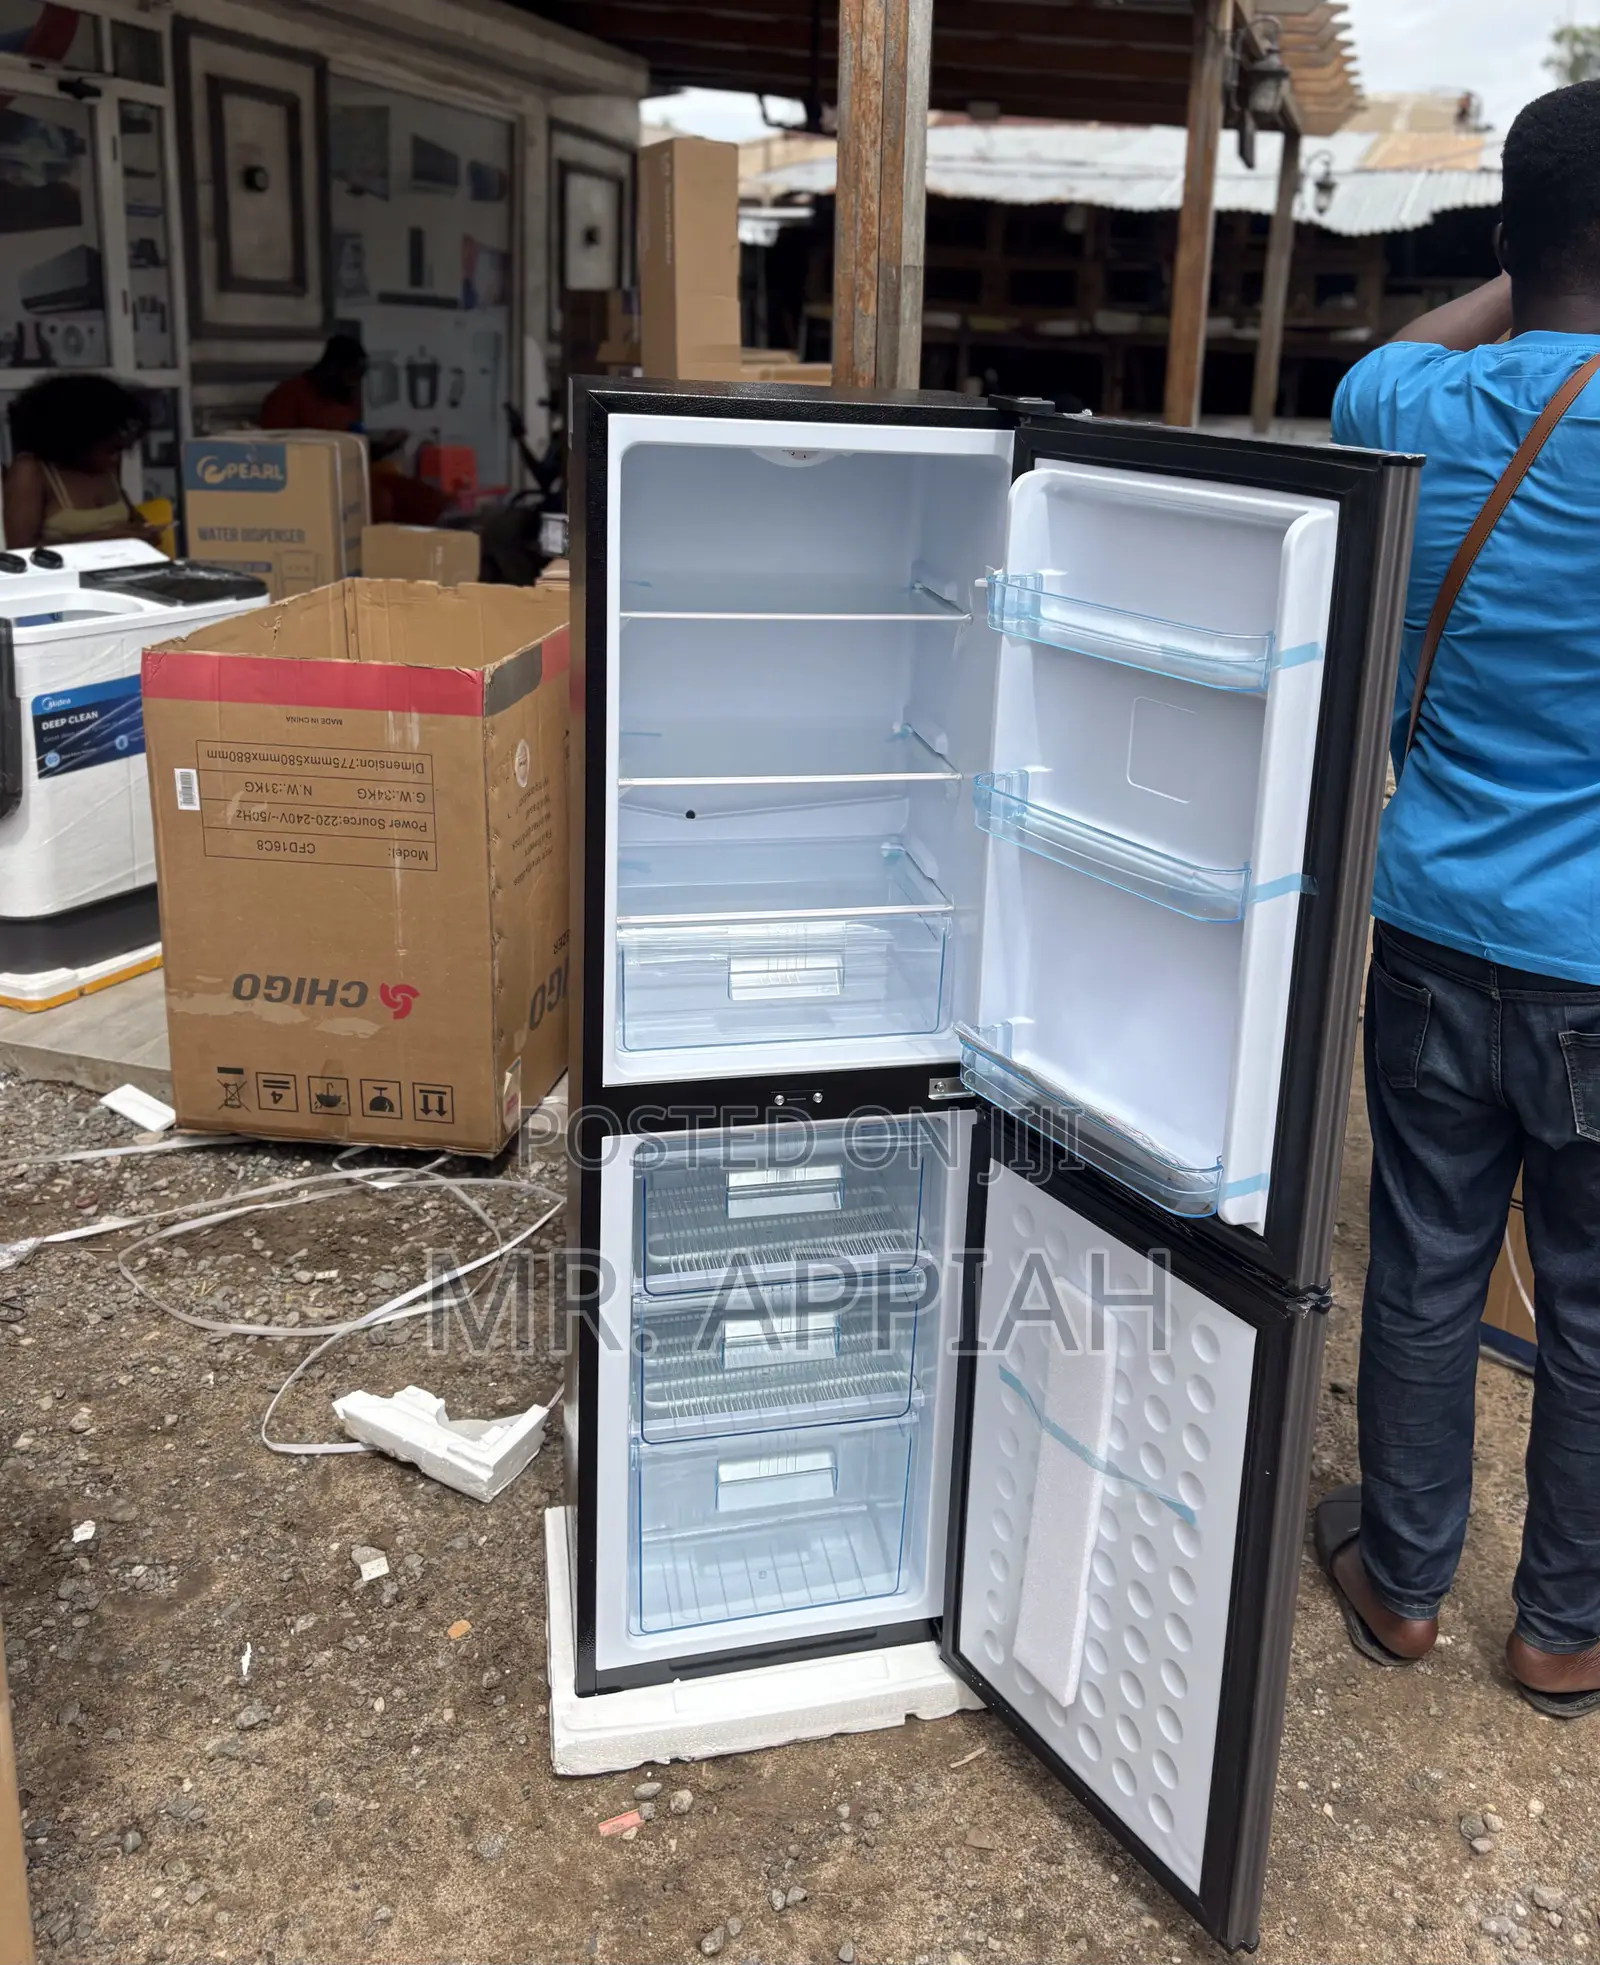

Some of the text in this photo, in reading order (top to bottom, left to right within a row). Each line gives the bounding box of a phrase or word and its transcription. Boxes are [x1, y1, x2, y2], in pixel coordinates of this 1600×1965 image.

[225, 462, 285, 481] PEARL
[197, 526, 306, 543] WATER DISPENSER
[47, 697, 72, 709] Midea
[42, 717, 67, 731] DEEP
[68, 711, 99, 725] CLEAN
[286, 715, 343, 726] MADE IN CHINA
[206, 749, 425, 774] Dimension:775mmx580mmx880mm
[388, 819, 428, 833] Power
[388, 847, 429, 861] Model:
[232, 973, 369, 1009] CHIGO
[271, 1090, 284, 1105] 4
